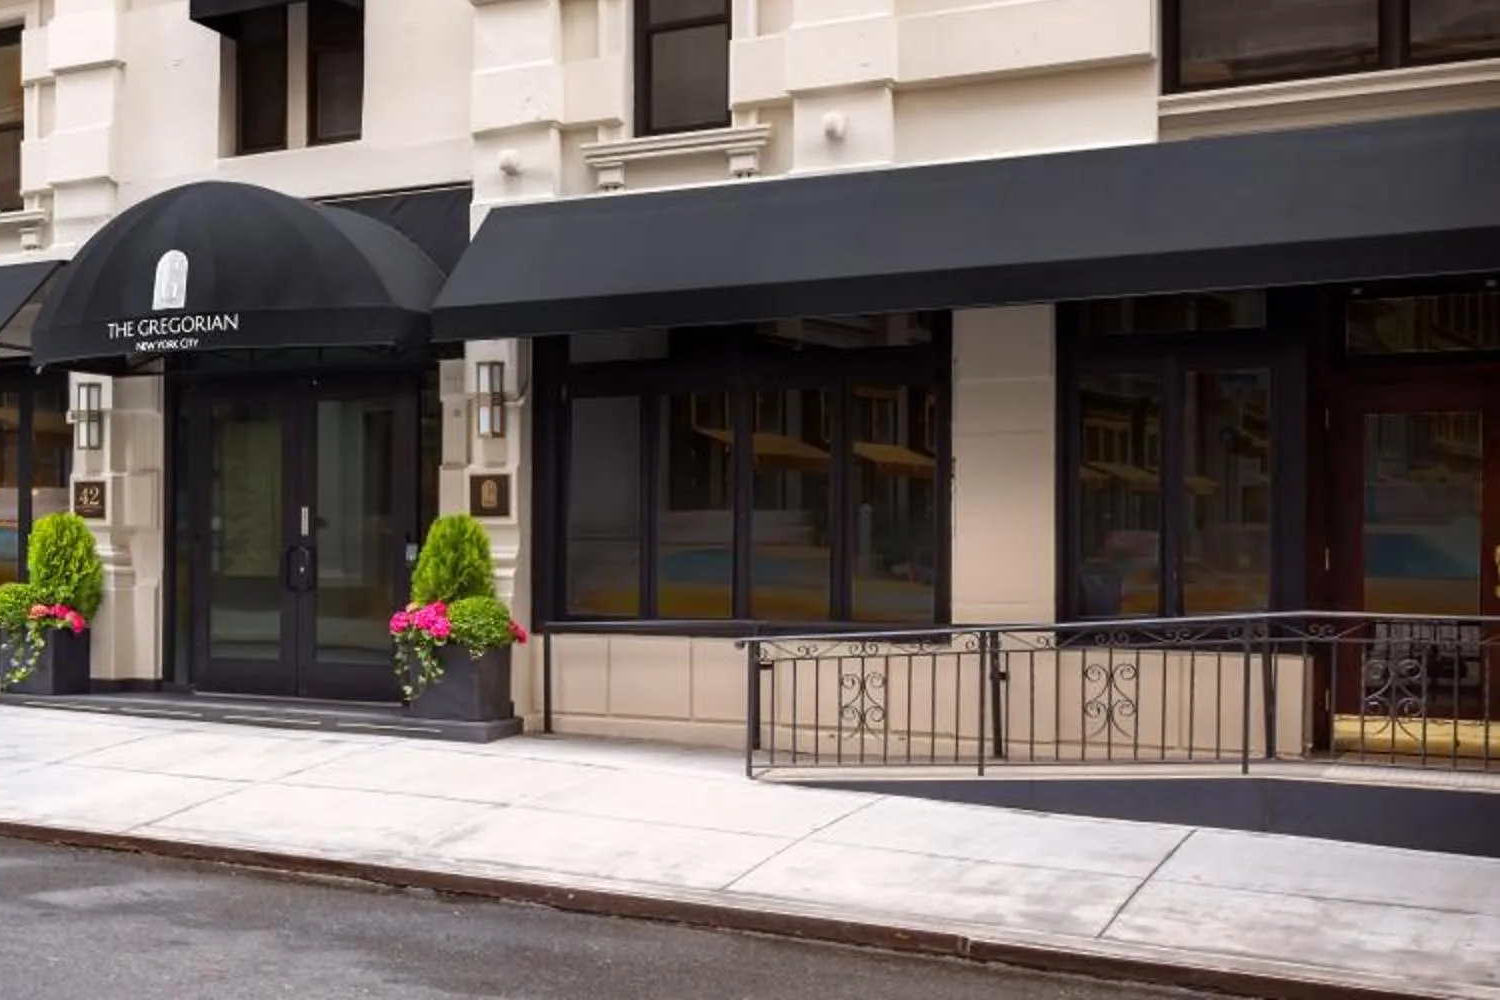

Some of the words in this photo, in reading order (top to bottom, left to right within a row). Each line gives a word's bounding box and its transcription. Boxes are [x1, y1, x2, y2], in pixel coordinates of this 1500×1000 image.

[108, 321, 134, 339] THE
[137, 313, 239, 337] GREGORIAN
[135, 341, 155, 351] NEW
[156, 339, 179, 349] YORK
[180, 337, 199, 349] CITY
[79, 487, 99, 505] 42
